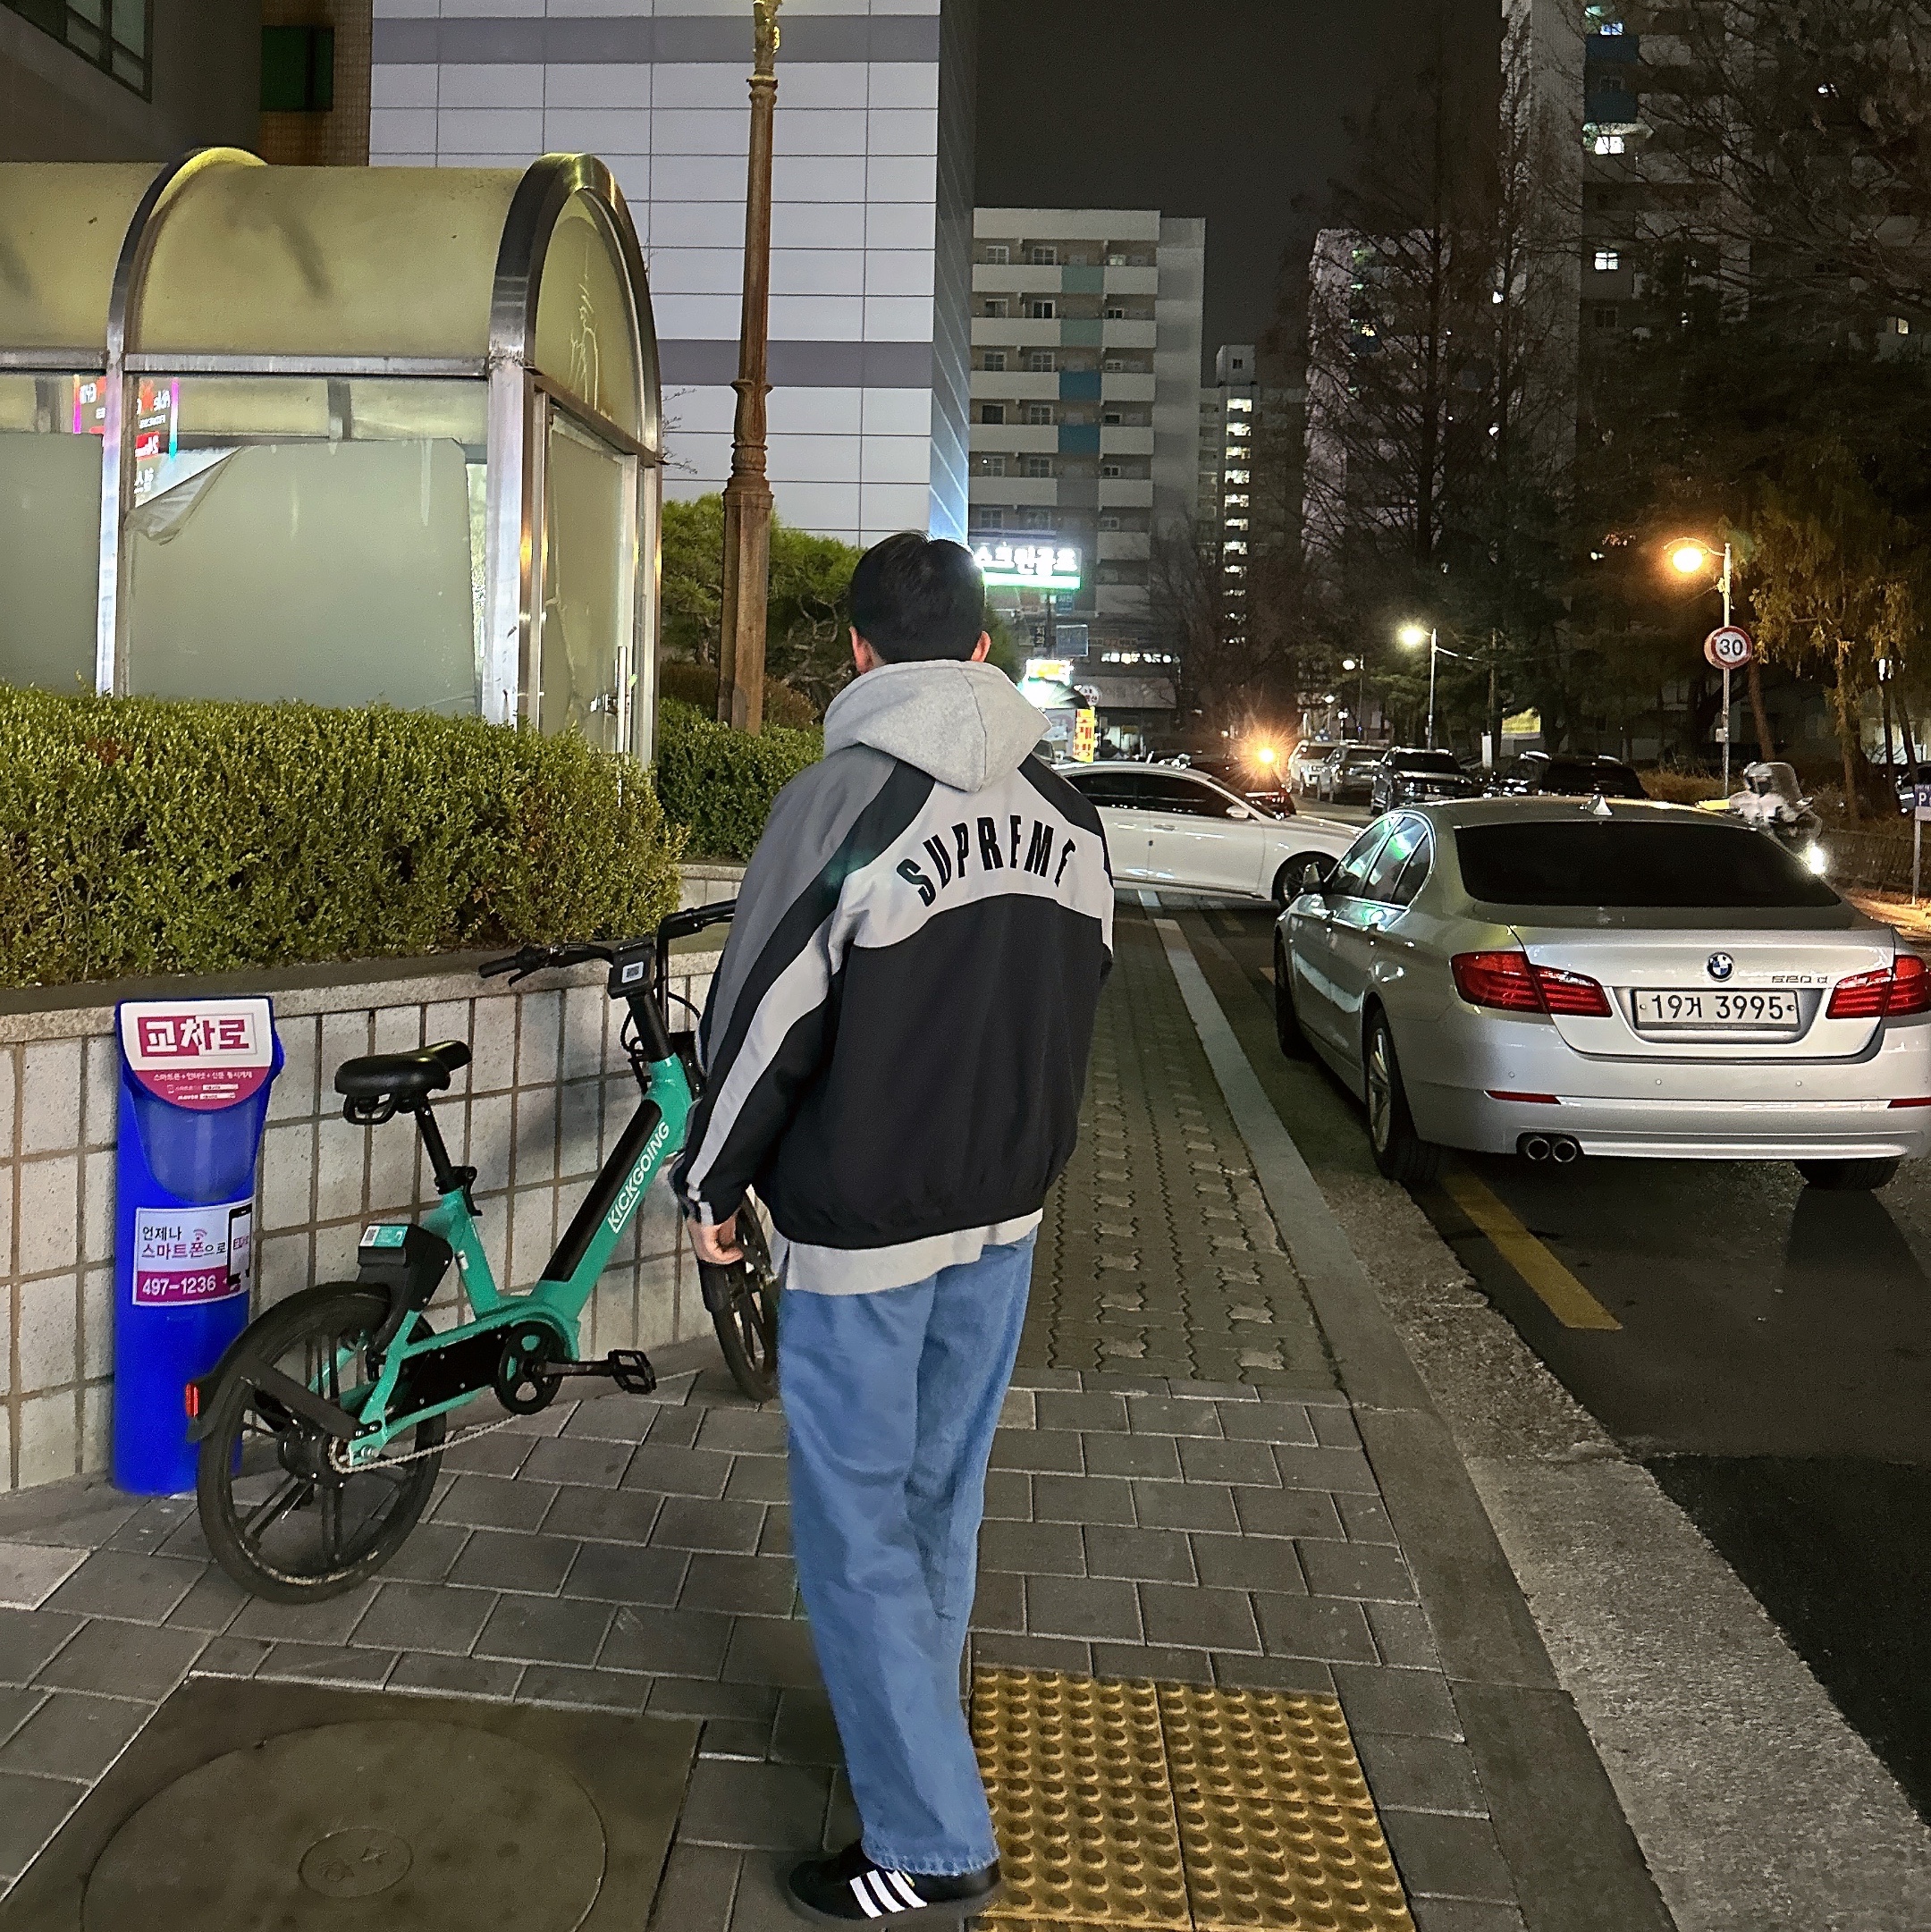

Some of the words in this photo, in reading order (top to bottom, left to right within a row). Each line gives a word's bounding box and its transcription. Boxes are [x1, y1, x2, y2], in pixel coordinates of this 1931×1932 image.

[1719, 638, 1743, 656] 30
[1652, 994, 1703, 1019] 19거
[1715, 995, 1784, 1020] 3995
[145, 1017, 250, 1053] 교차로
[607, 1121, 670, 1233] KICKGOING
[142, 1226, 182, 1241] 언제나
[141, 1242, 227, 1260] 스마트폰으로
[142, 1274, 216, 1295] 497-1236
